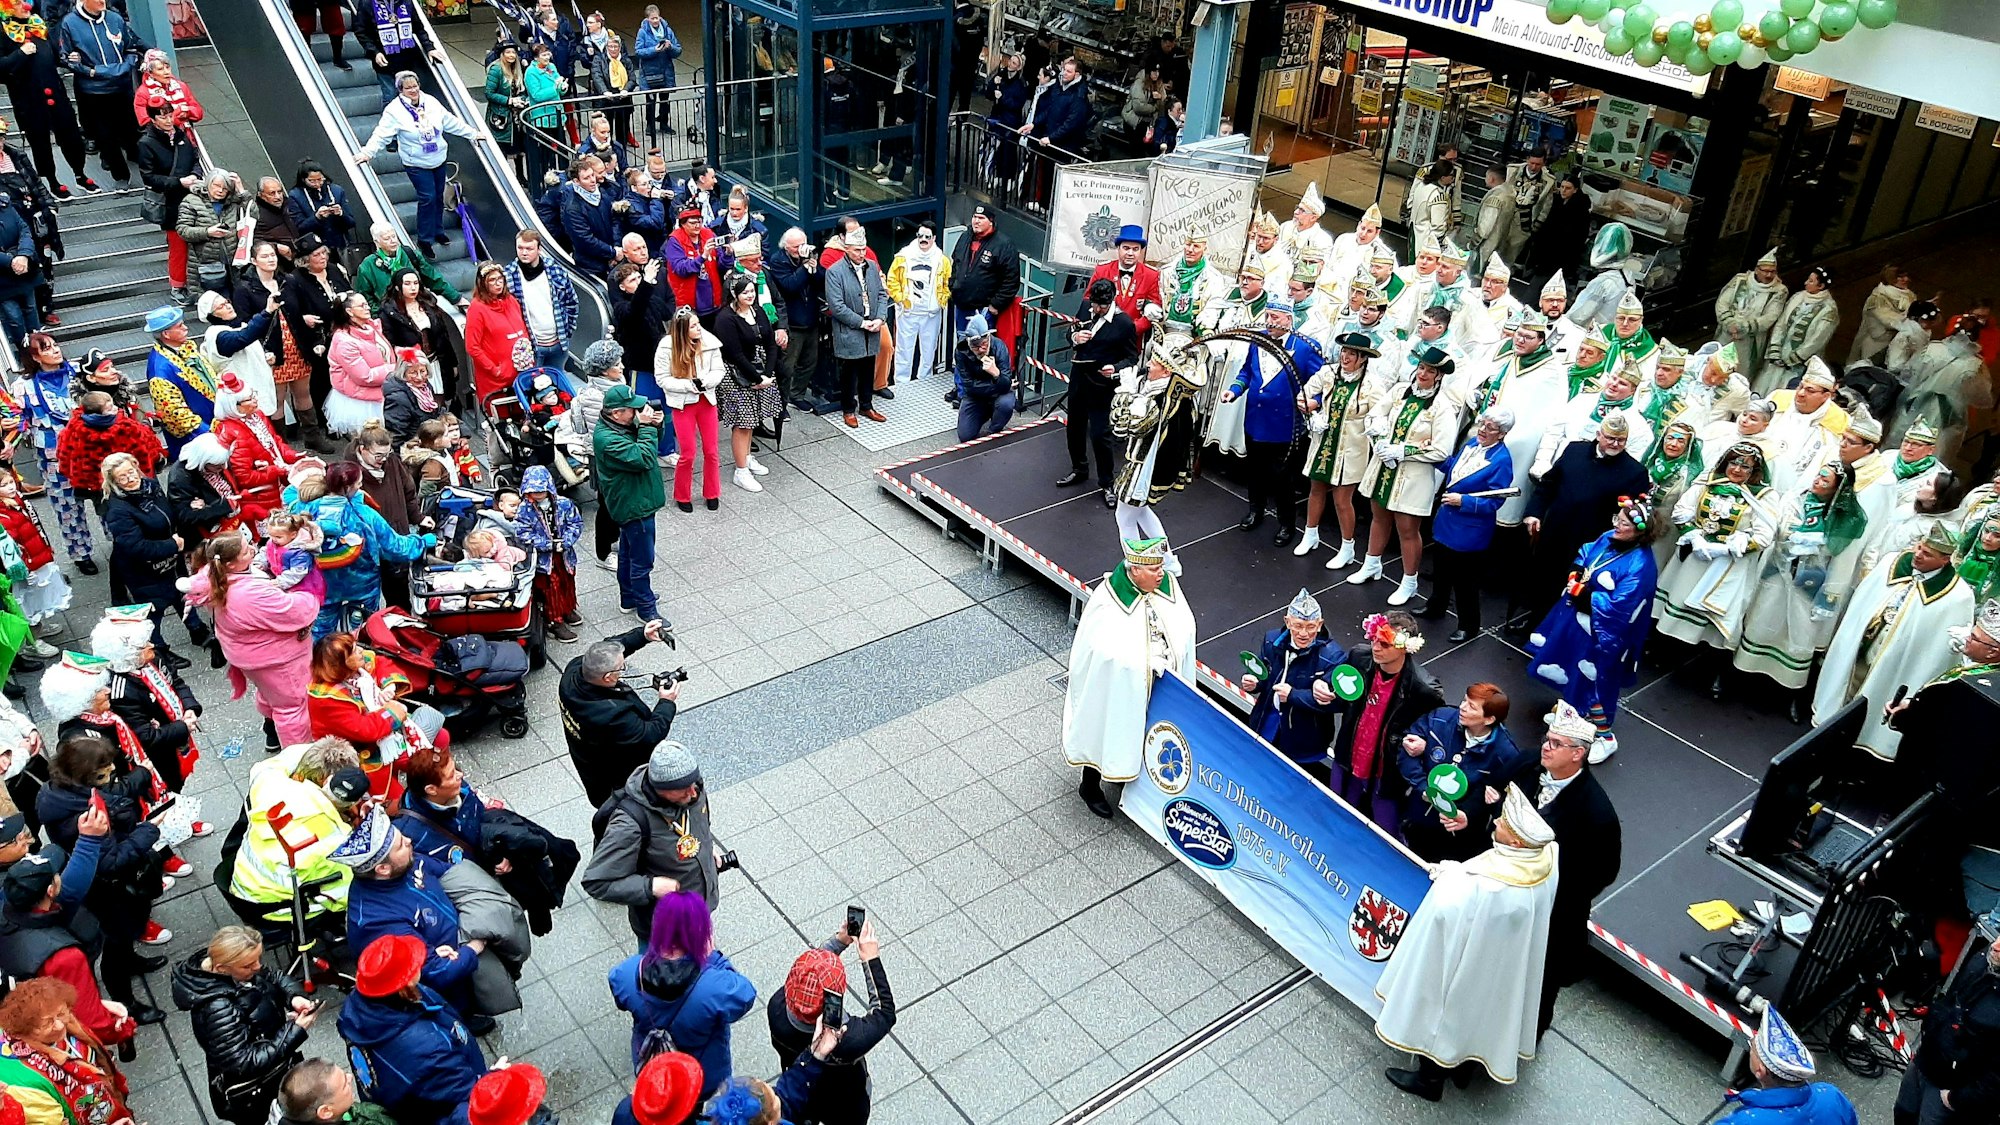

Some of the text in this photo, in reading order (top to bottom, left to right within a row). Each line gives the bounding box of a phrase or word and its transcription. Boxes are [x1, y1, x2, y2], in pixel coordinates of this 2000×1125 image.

[1491, 16, 1519, 37] Mein
[1849, 86, 1898, 105] Restaurant
[1844, 98, 1896, 116] EL BODEGON
[1922, 106, 1974, 125] Restaurant
[1929, 119, 1972, 136] BODEGON
[1066, 191, 1112, 201] Leverkusen
[1115, 194, 1134, 203] 1937
[1073, 180, 1144, 195] KG Prinzengarde
[1154, 188, 1243, 245] Prinzengarde
[1211, 210, 1237, 229] 1954
[1165, 808, 1233, 855] SuperStar
[1197, 762, 1350, 900] KG Dhünnveilchen
[1235, 822, 1266, 858] 1975
